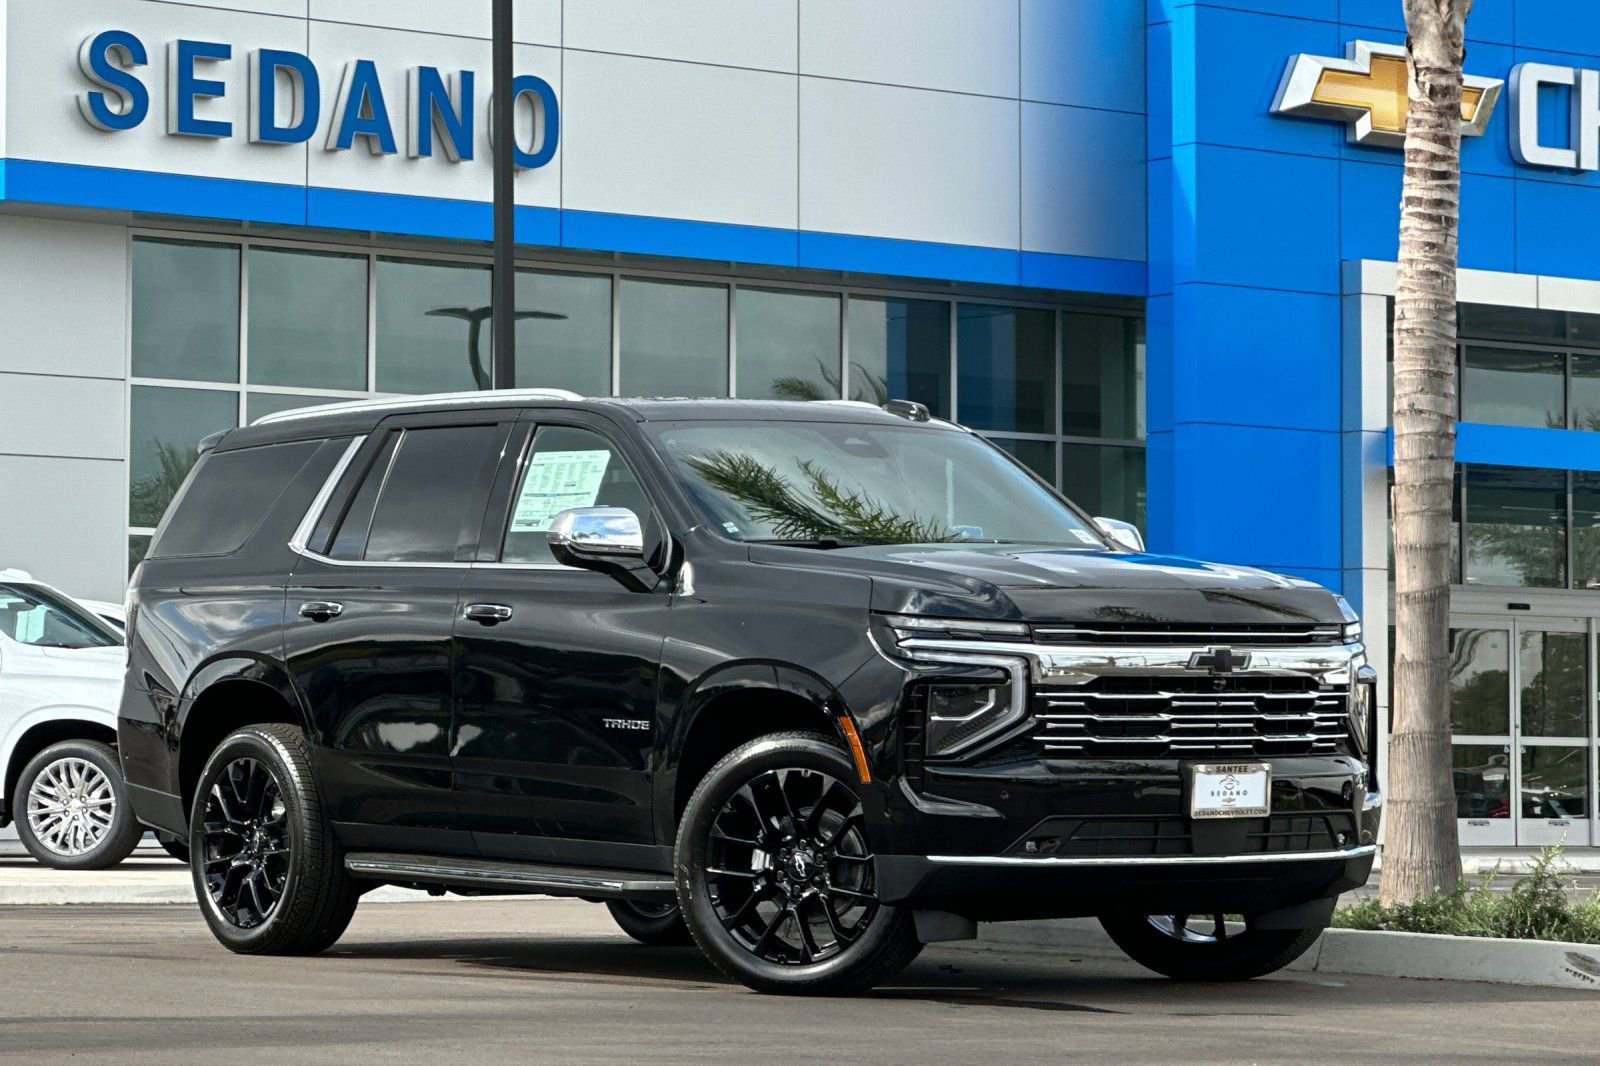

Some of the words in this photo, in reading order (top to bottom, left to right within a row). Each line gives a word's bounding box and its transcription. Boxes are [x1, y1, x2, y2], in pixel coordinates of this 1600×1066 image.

[78, 30, 559, 169] SEDANO
[602, 718, 650, 730] TAHOE
[1215, 765, 1249, 773] SANTEE
[1193, 808, 1268, 817] SEDANOCHEVROLET.COM
